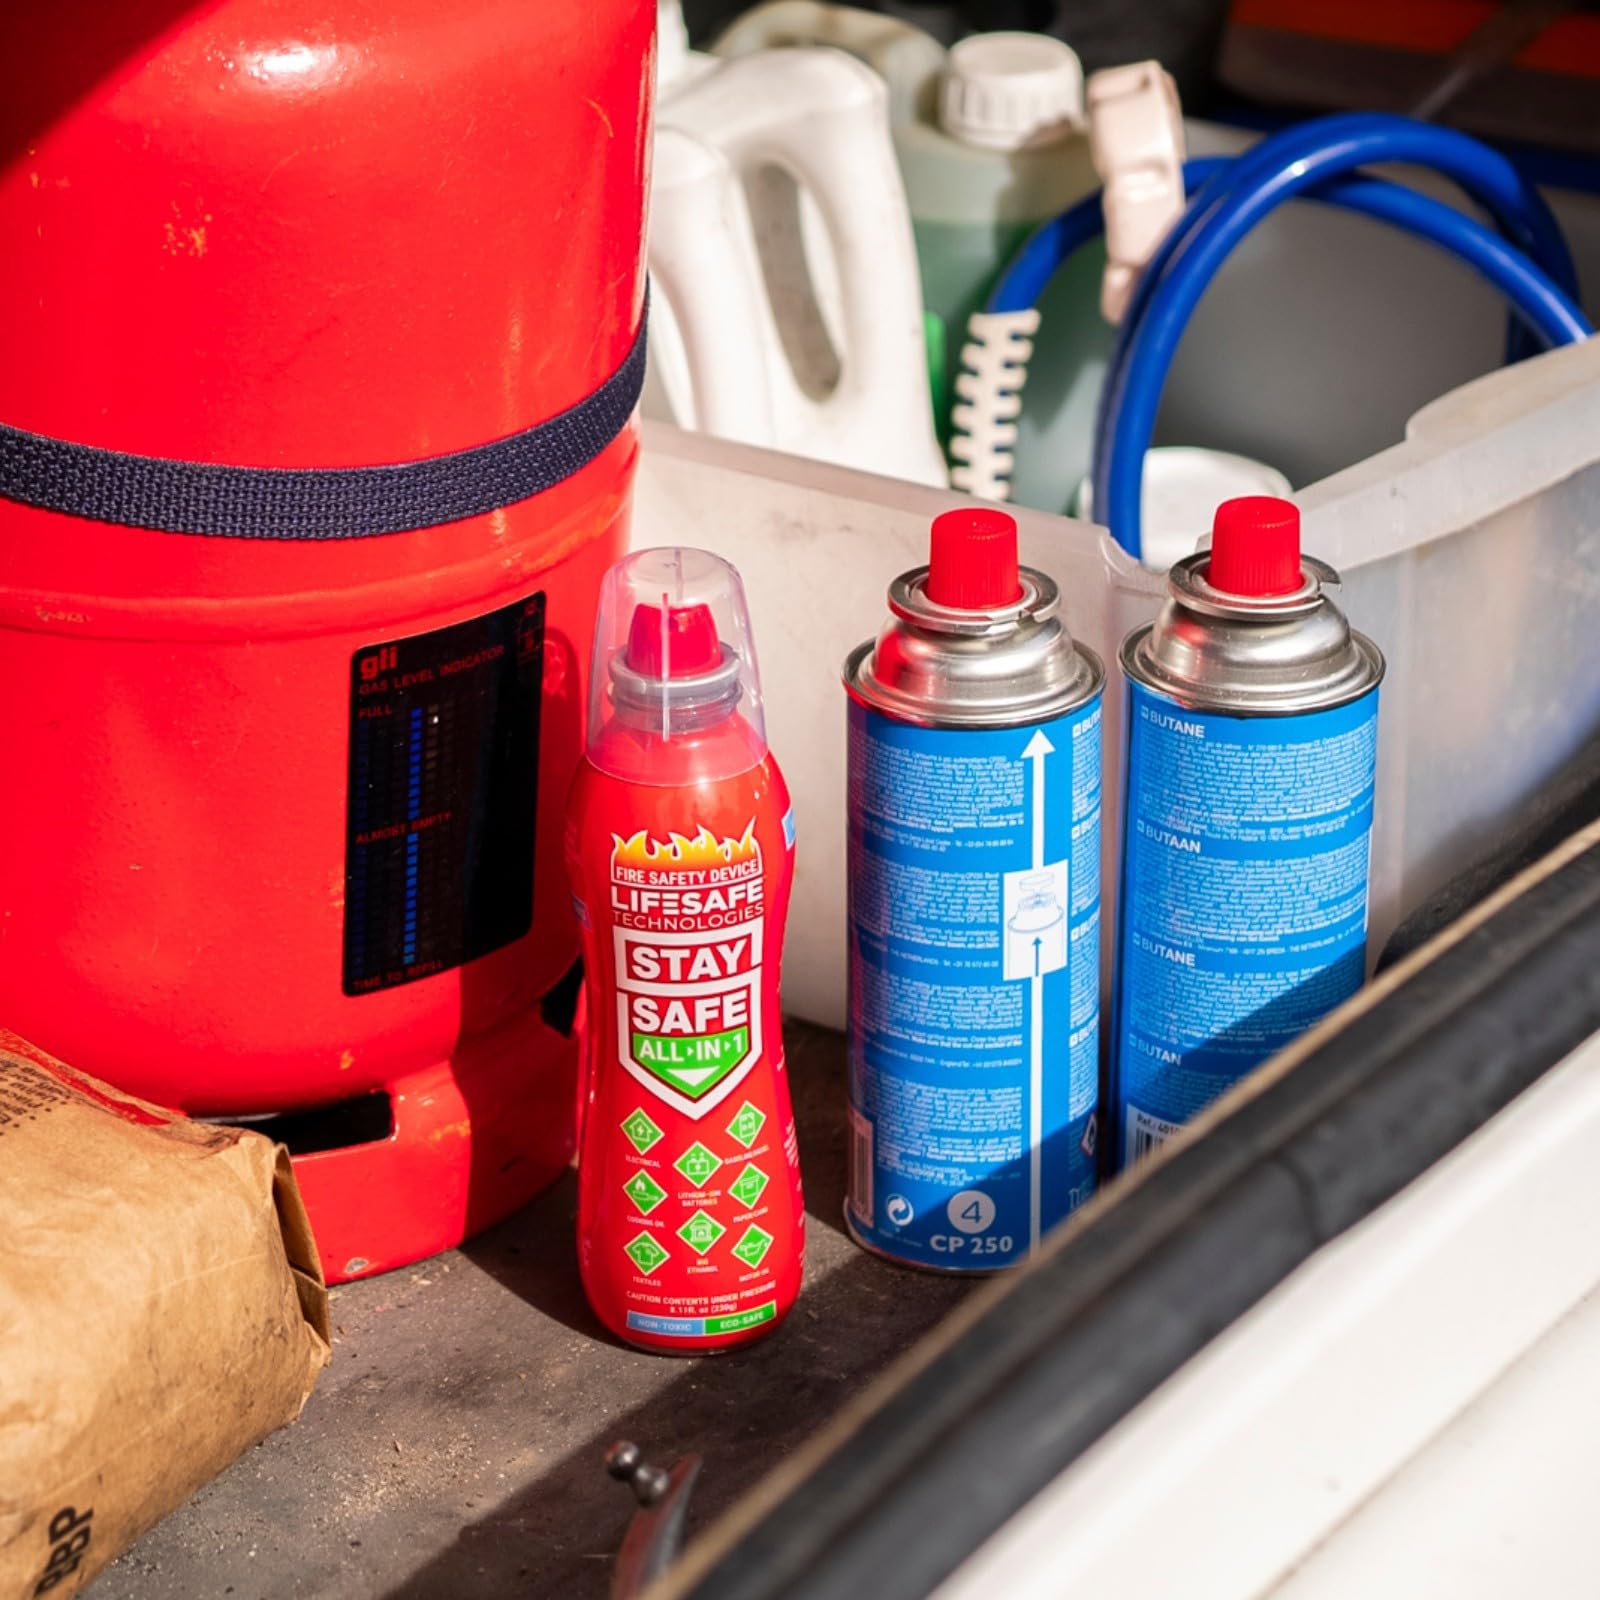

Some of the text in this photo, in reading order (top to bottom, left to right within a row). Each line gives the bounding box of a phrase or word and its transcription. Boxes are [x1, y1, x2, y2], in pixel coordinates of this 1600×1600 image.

[359, 704, 393, 719] FULL
[1150, 709, 1205, 739] BUTANE
[355, 810, 451, 843] ALMOST EMPTY
[1145, 823, 1201, 853] BUTAAN
[616, 859, 758, 885] FIRE SAFETY DEVICE
[611, 877, 764, 915] LIFESAFE
[612, 901, 764, 930] TECHNOLOGIES
[631, 938, 747, 981] STAY
[1141, 938, 1196, 966] BUTANE
[632, 989, 748, 1034] SAFE
[639, 1033, 743, 1062] ALL IN 1
[1138, 1039, 1182, 1067] BUTAN
[961, 1200, 982, 1225] 4
[929, 1233, 965, 1253] CP
[970, 1235, 1013, 1255] 250
[626, 1279, 777, 1306] CAUTION CONTENTS UNDER PRESSURE
[637, 1318, 693, 1332] NON-TOXIC
[719, 1311, 765, 1330] ECO-SAFE
